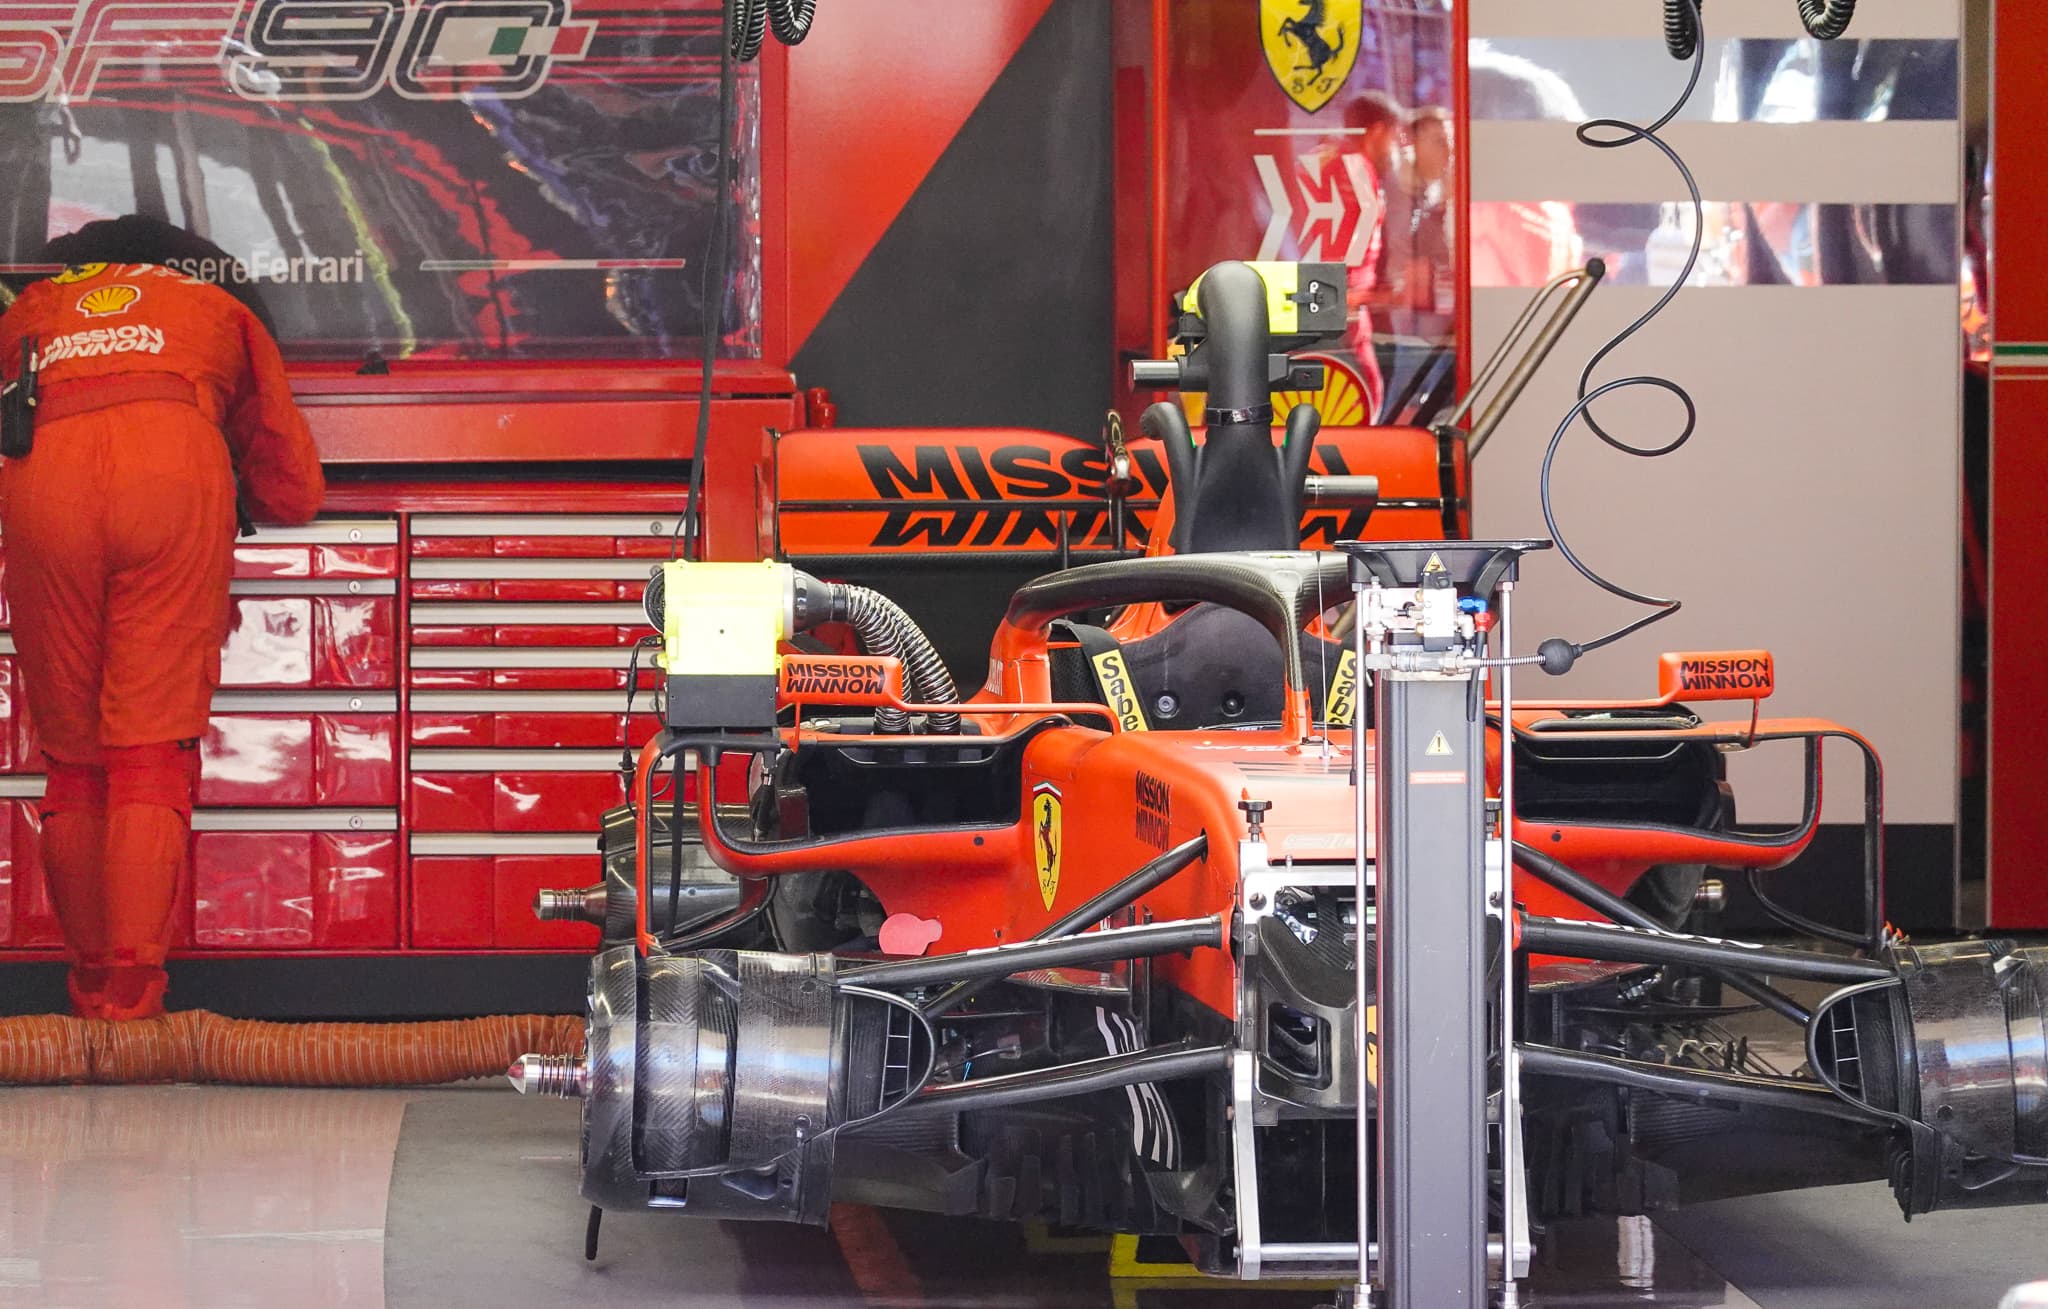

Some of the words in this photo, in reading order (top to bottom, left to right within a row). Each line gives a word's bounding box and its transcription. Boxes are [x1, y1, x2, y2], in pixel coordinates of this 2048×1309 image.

[44, 324, 163, 353] MISSION
[40, 337, 165, 370] WINNOW
[856, 445, 1352, 500] MISSI
[870, 504, 1374, 547] WINNW
[787, 663, 886, 679] MISSION
[1681, 659, 1768, 674] MISSION
[786, 678, 885, 694] WINNOW
[1681, 673, 1770, 690] WINNOW
